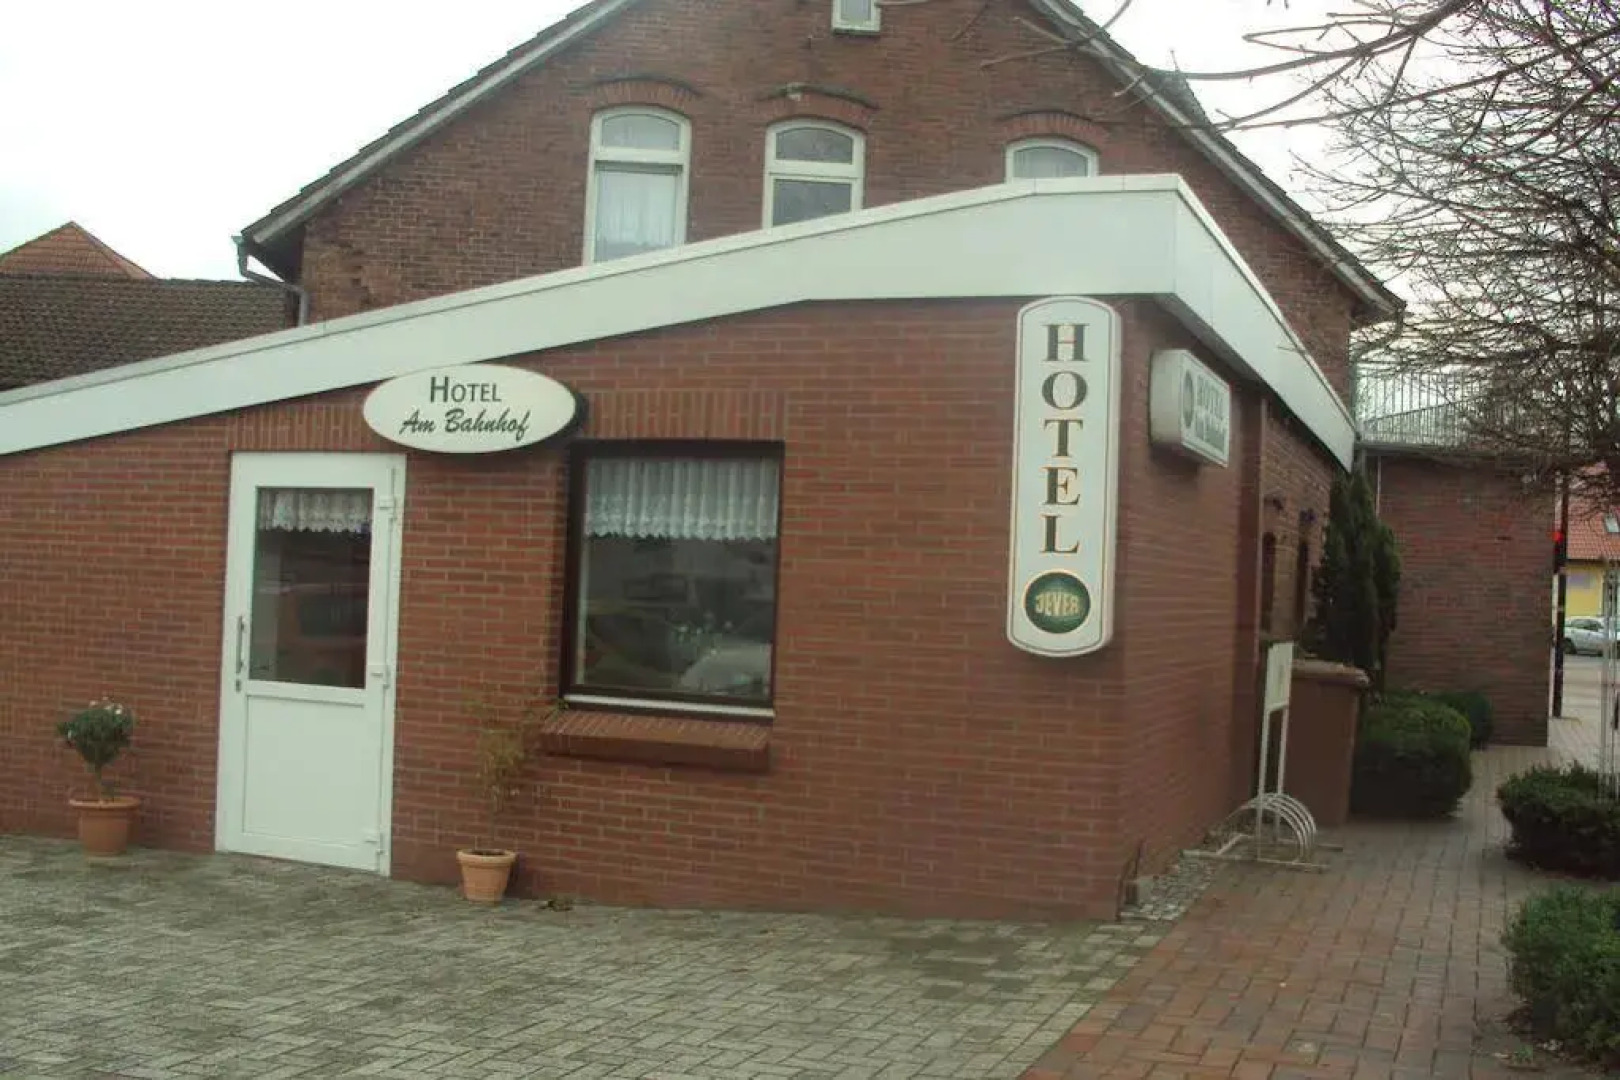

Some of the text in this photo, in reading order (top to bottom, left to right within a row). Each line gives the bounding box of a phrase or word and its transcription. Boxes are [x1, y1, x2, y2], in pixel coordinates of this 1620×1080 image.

[399, 407, 531, 442] Am Bahnhof
[1039, 322, 1090, 554] HOTEL
